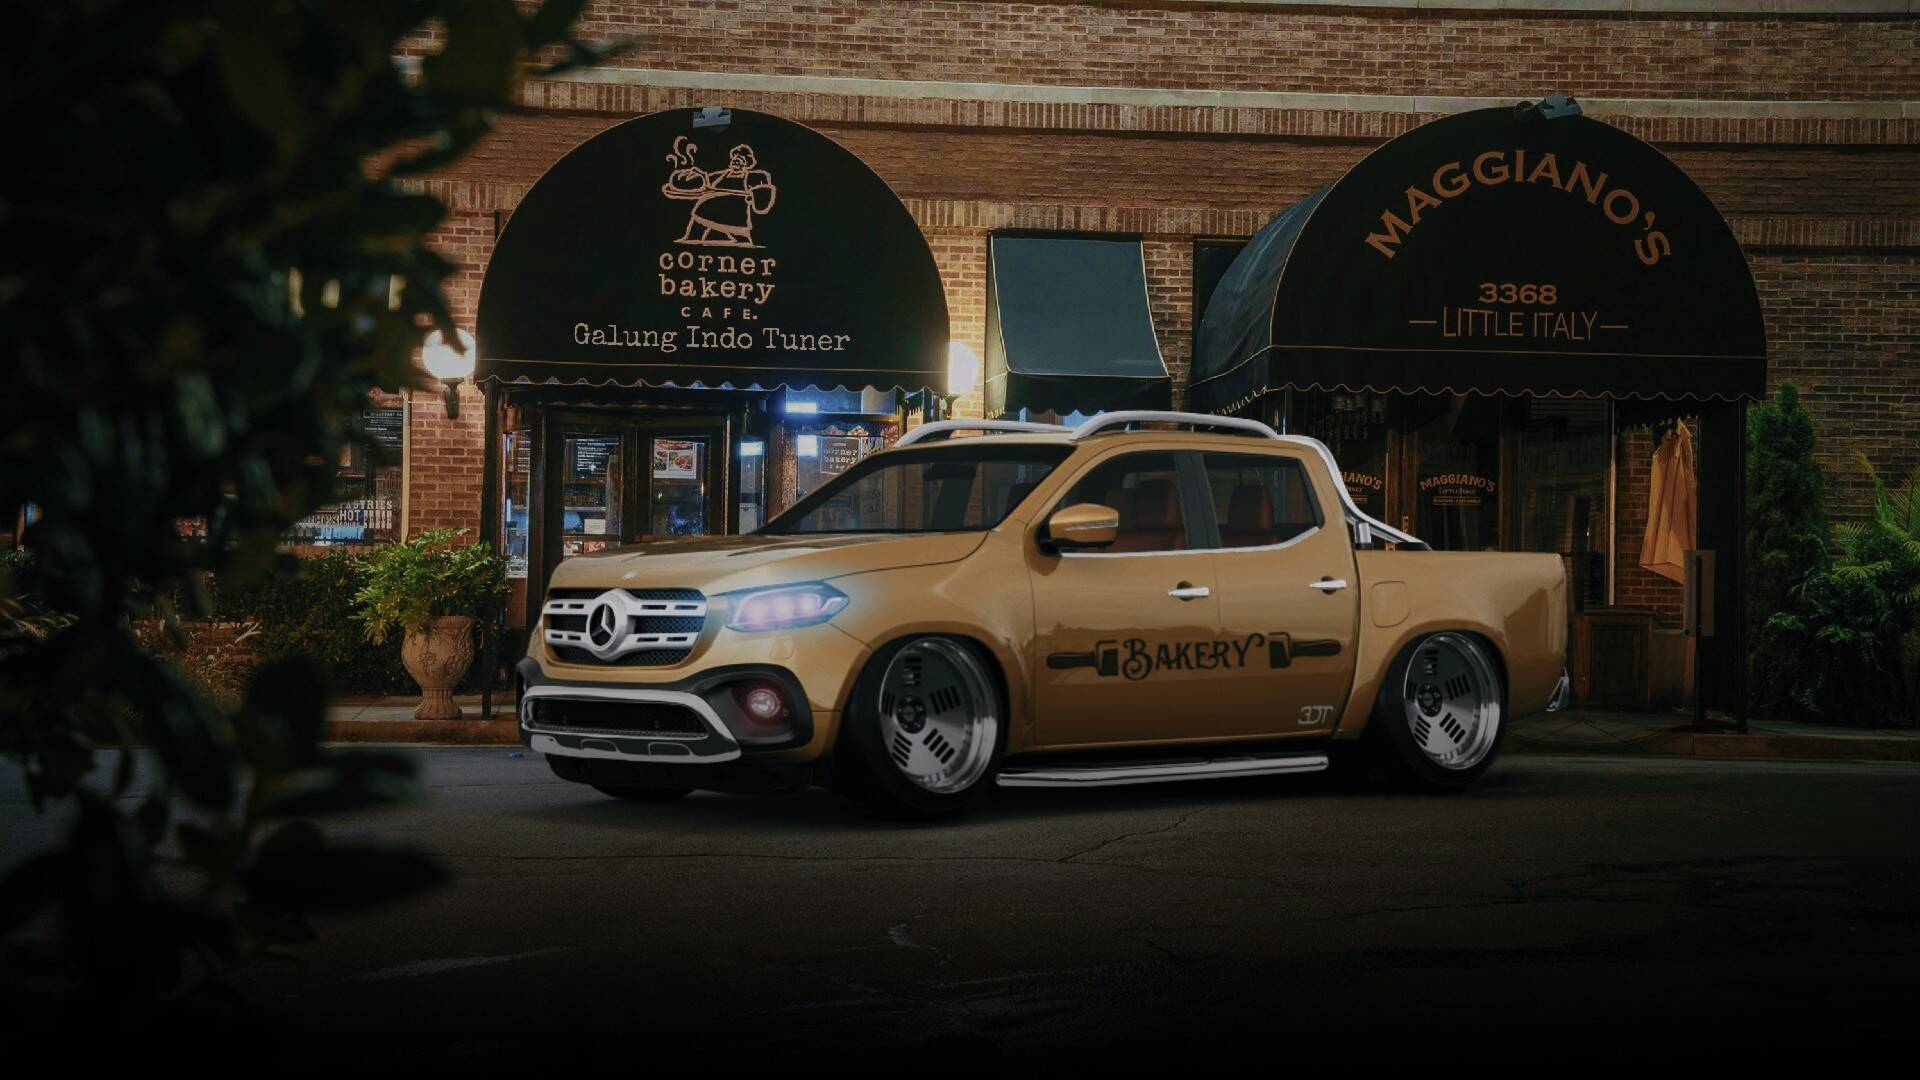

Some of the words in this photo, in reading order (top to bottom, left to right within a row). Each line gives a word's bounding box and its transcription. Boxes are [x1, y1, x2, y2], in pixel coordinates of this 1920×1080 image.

[1364, 149, 1672, 267] MAGGIANO'S
[659, 250, 776, 277] corner
[658, 273, 776, 304] bakery
[1478, 281, 1558, 305] 3368
[574, 322, 677, 353] Galung
[686, 325, 753, 350] Indo
[762, 327, 851, 351] Tuner
[1442, 306, 1525, 337] LITTLE
[1533, 311, 1598, 341] ITALY
[1341, 471, 1382, 490] IANO'S
[1420, 473, 1497, 492] MAGGIANO'S
[340, 510, 361, 521] HOT
[1122, 633, 1265, 681] BAKERY
